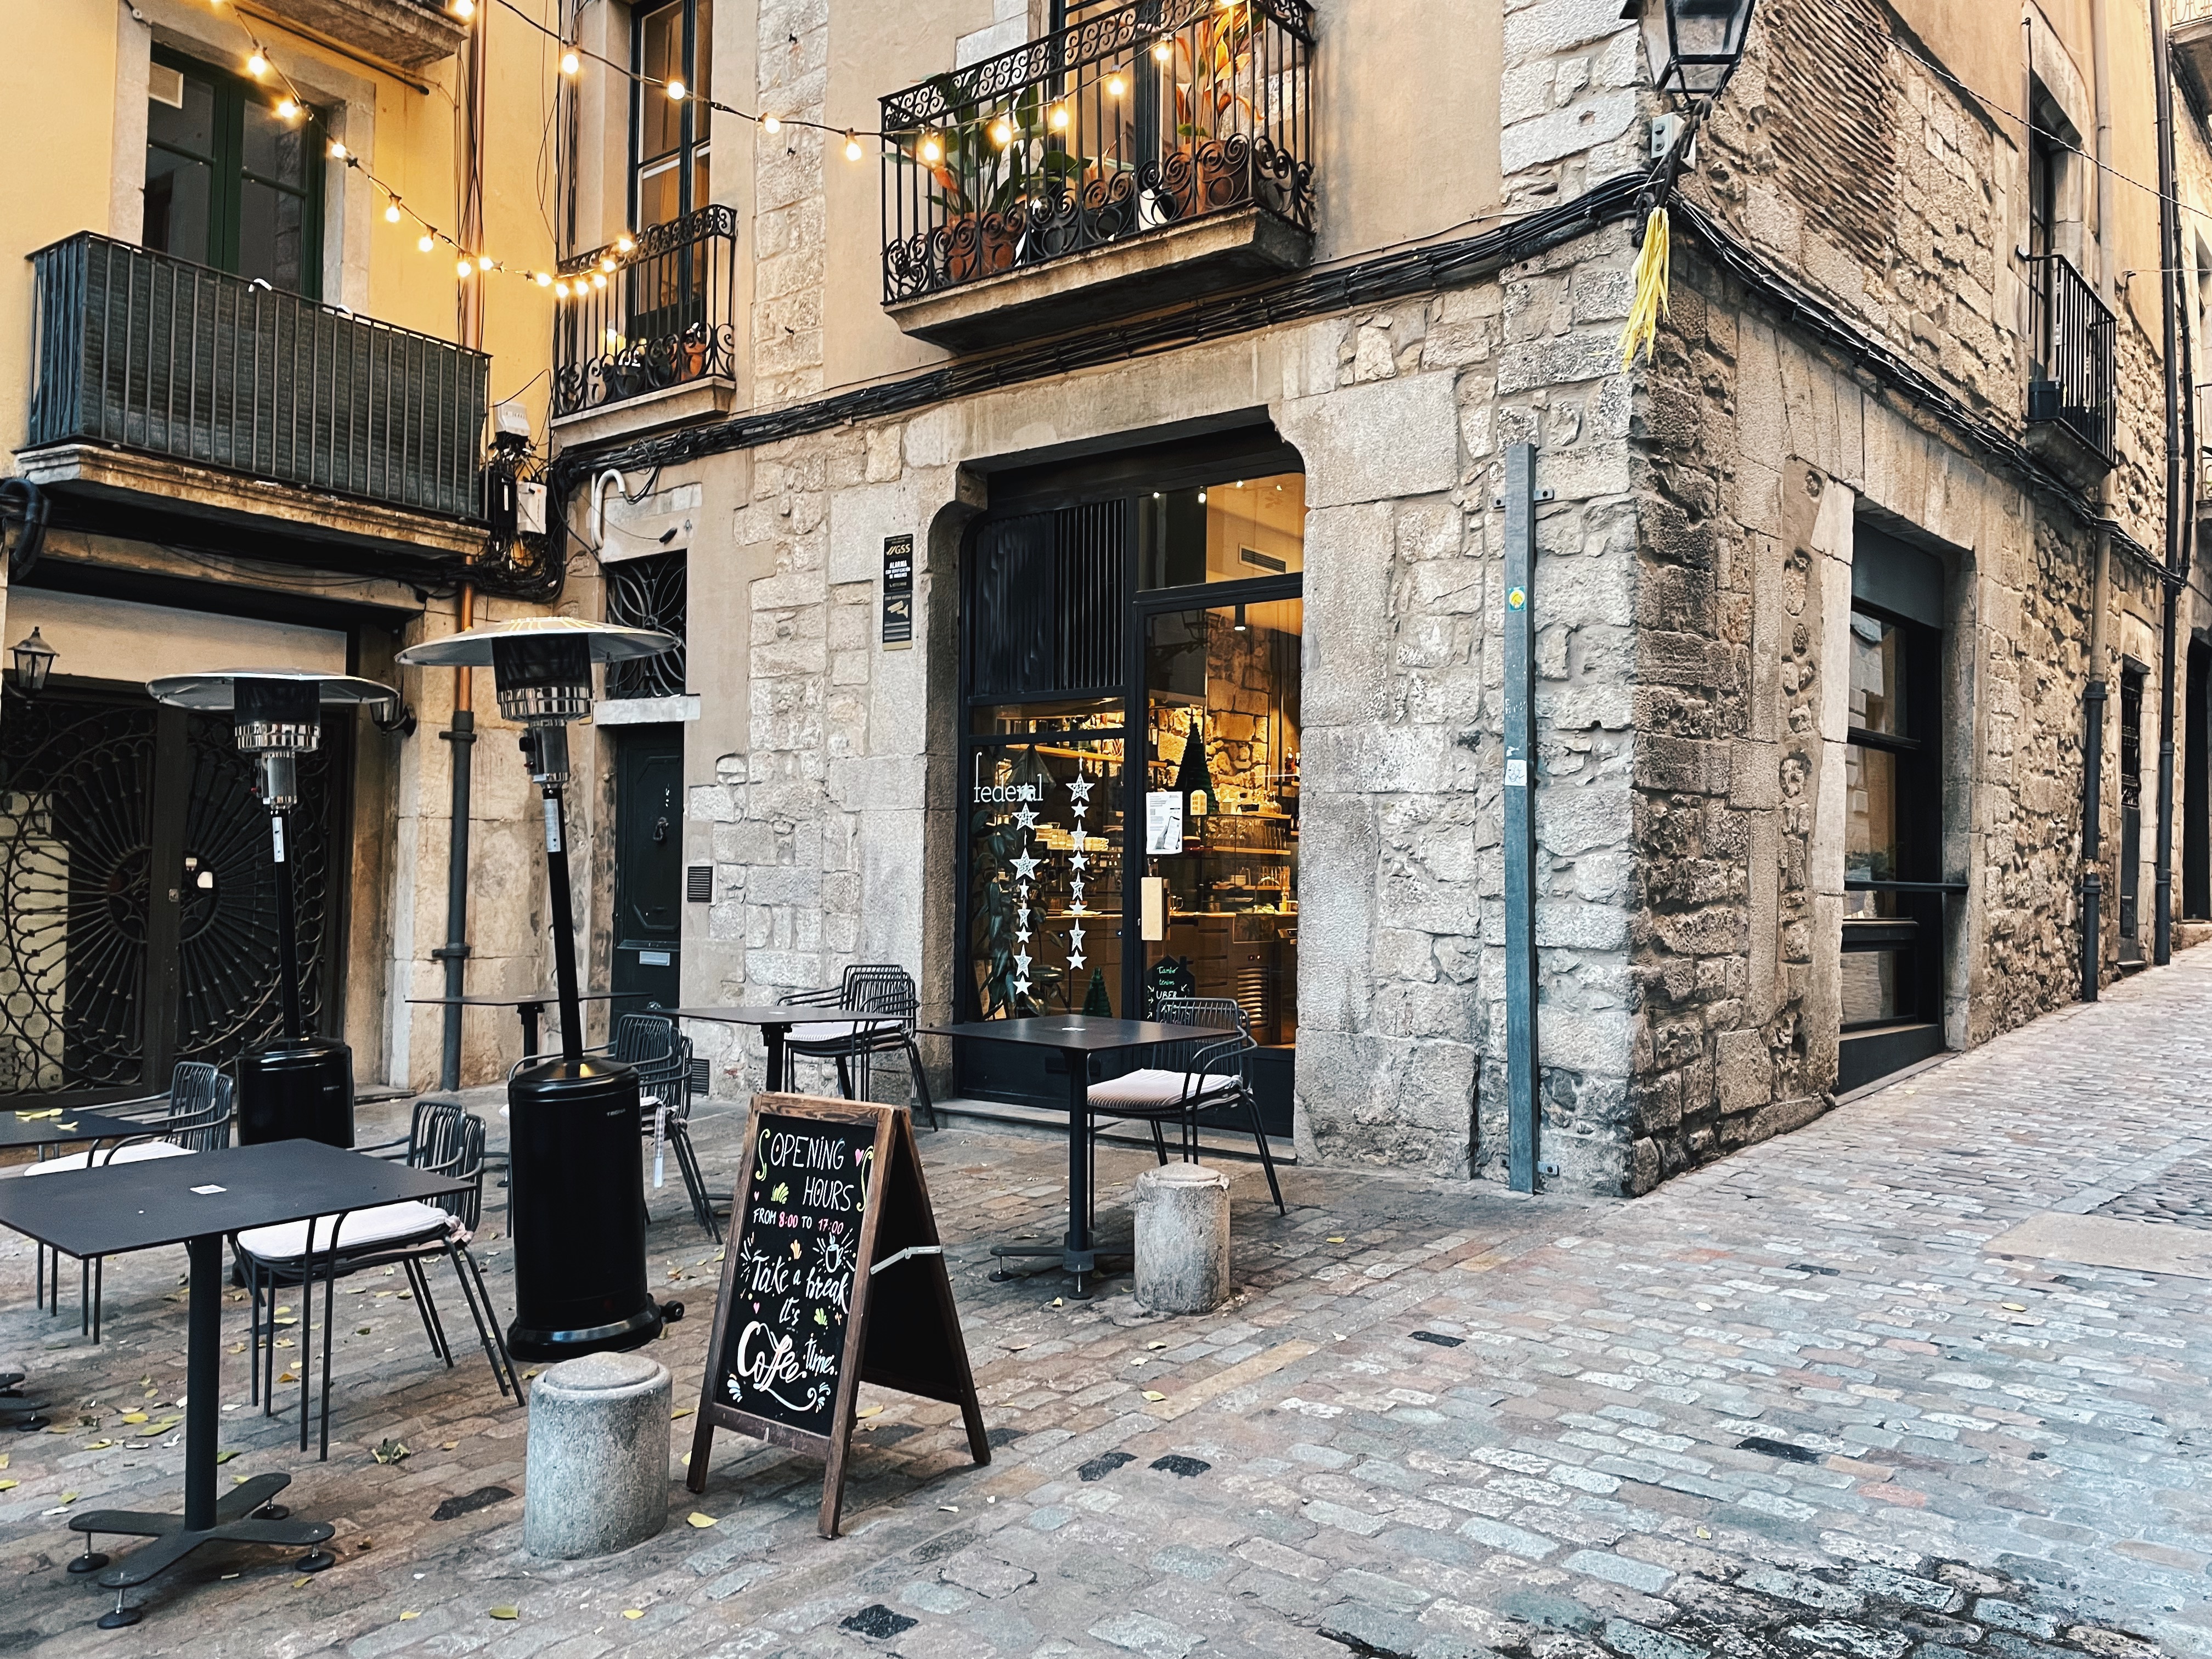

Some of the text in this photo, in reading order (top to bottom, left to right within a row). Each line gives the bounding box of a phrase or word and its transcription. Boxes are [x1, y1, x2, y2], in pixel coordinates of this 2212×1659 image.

[973, 751, 1043, 803] federal
[1156, 990, 1177, 999] UBER
[770, 1132, 845, 1170] OPENING
[802, 1176, 855, 1211] HOURS
[753, 1207, 844, 1235] FROM 8:00 TO 17:00
[752, 1255, 850, 1314] Take a break
[779, 1296, 800, 1326] It's
[737, 1321, 808, 1392] Coffee
